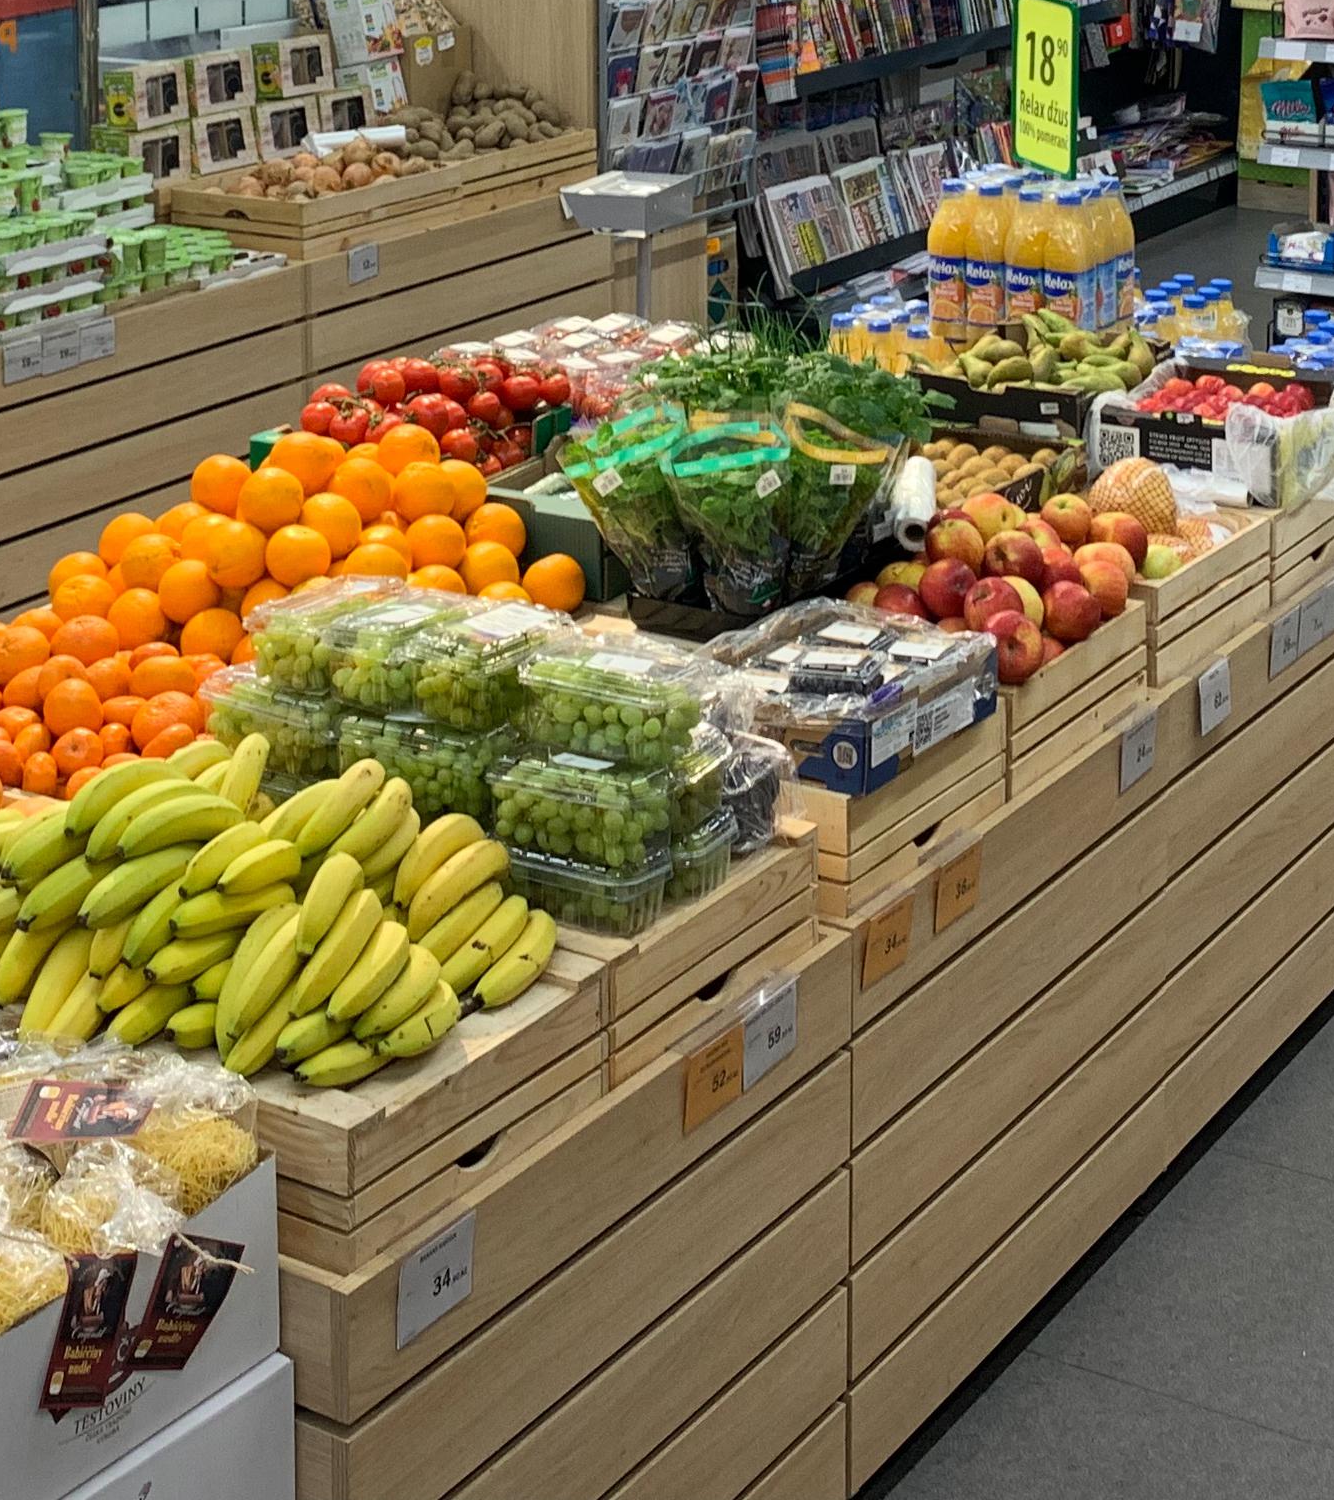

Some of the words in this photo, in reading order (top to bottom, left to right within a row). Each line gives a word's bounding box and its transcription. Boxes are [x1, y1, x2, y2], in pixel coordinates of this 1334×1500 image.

[1026, 31, 1055, 87] 18
[1057, 38, 1068, 58] 90
[1020, 90, 1045, 119] Relax
[930, 258, 960, 276] Relax
[967, 263, 997, 280] Relax
[1006, 269, 1036, 287] Relax
[1044, 273, 1076, 291] Relax
[74, 1376, 146, 1434] TĚSTOVINY
